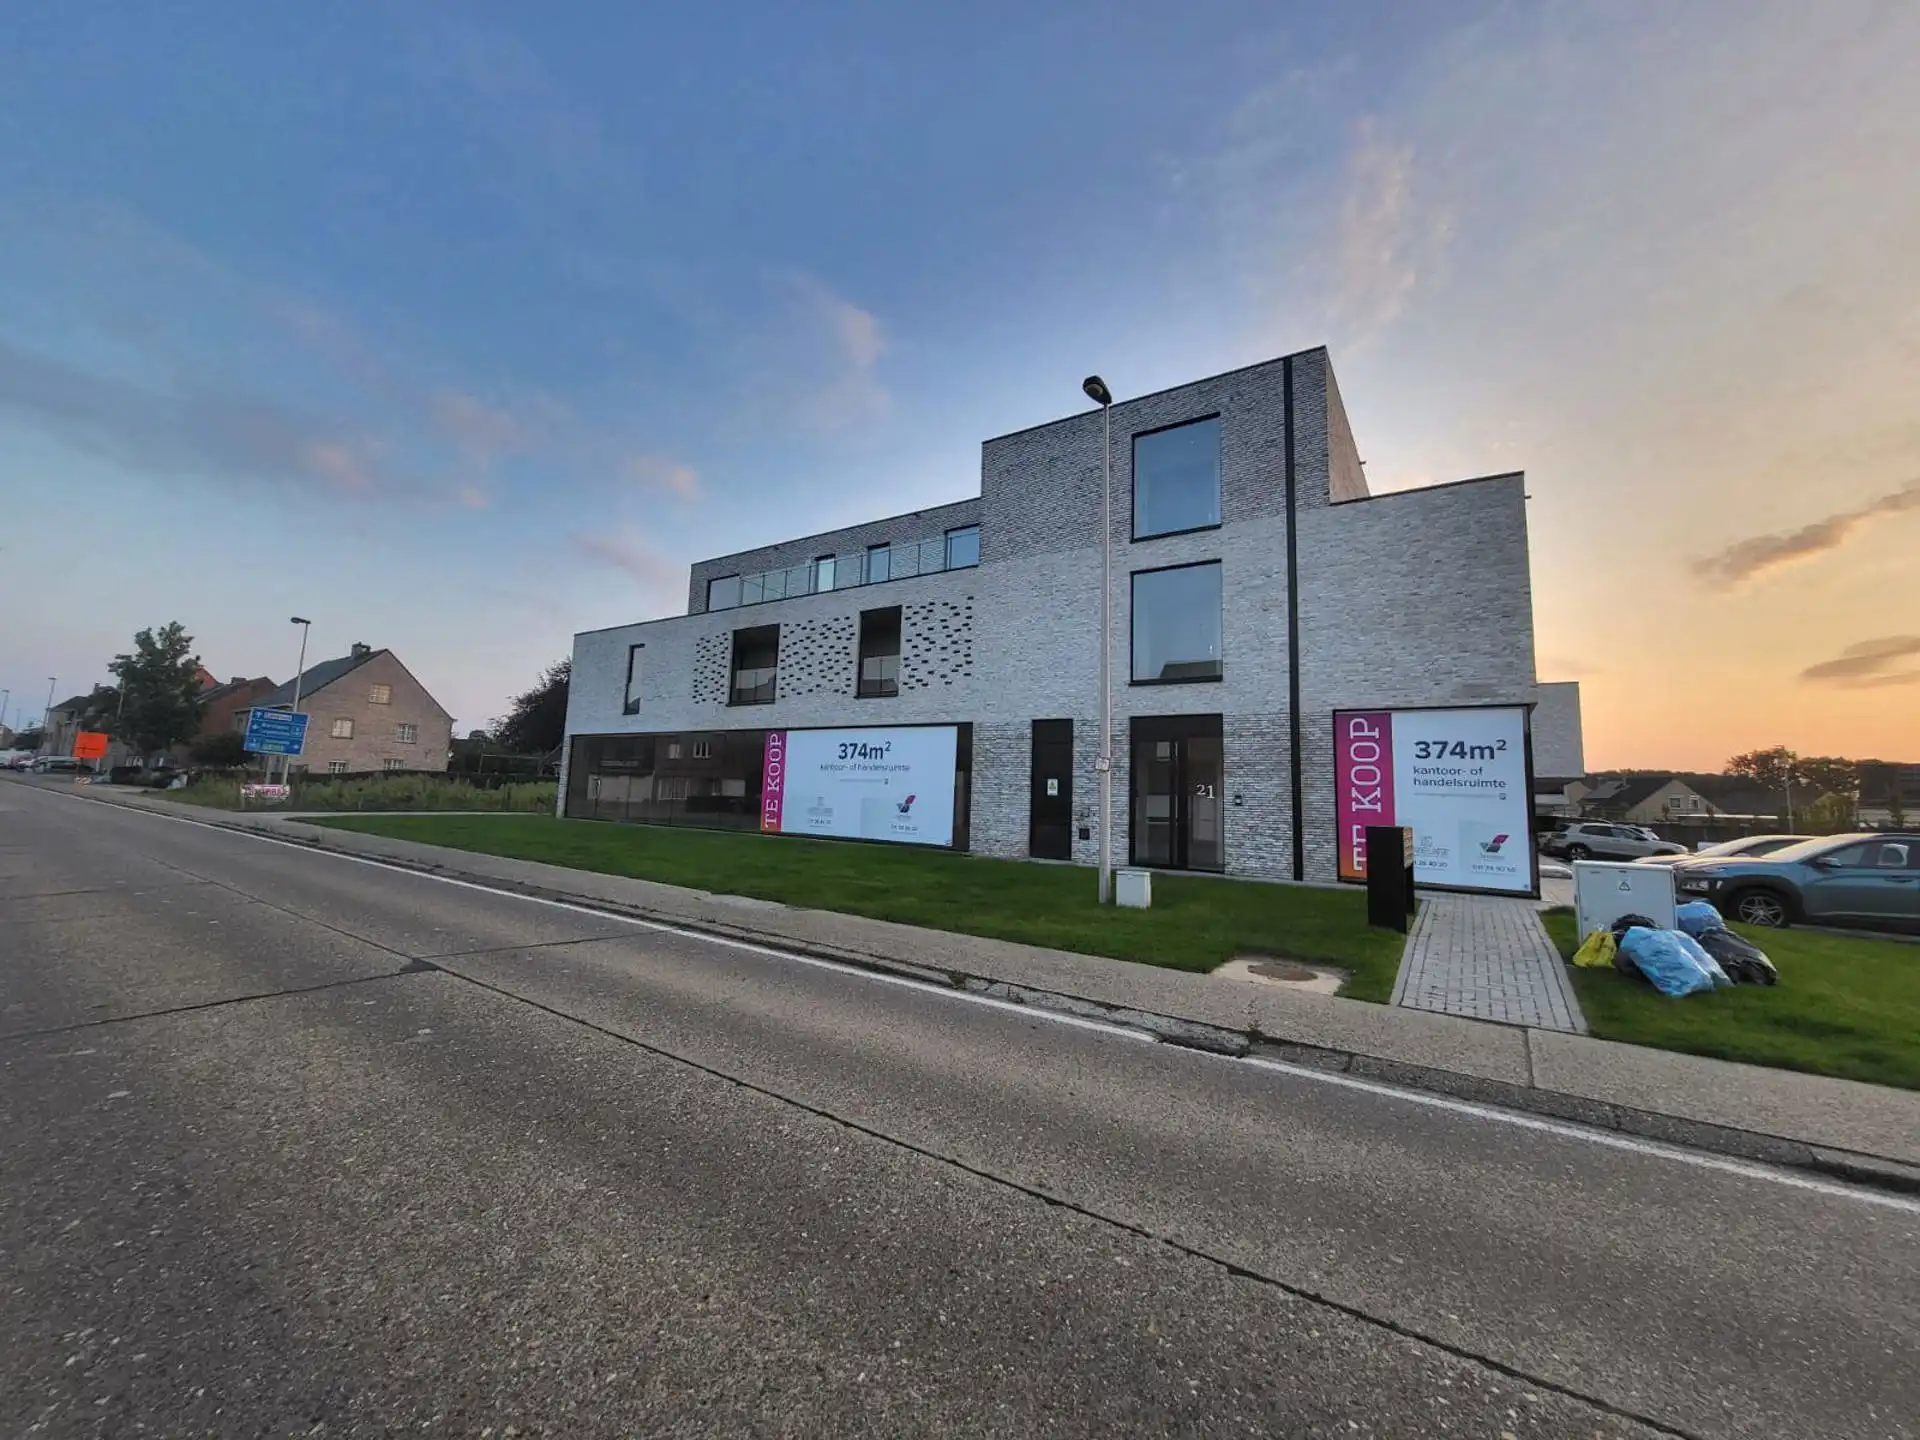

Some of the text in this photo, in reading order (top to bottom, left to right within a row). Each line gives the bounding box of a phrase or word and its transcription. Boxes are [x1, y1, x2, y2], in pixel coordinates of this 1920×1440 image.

[1350, 718, 1382, 813] KOOP
[1413, 765, 1483, 776] kantoor- of
[764, 733, 782, 829] TE KOOP
[1413, 777, 1507, 789] handelsruimte
[1196, 783, 1215, 799] 21
